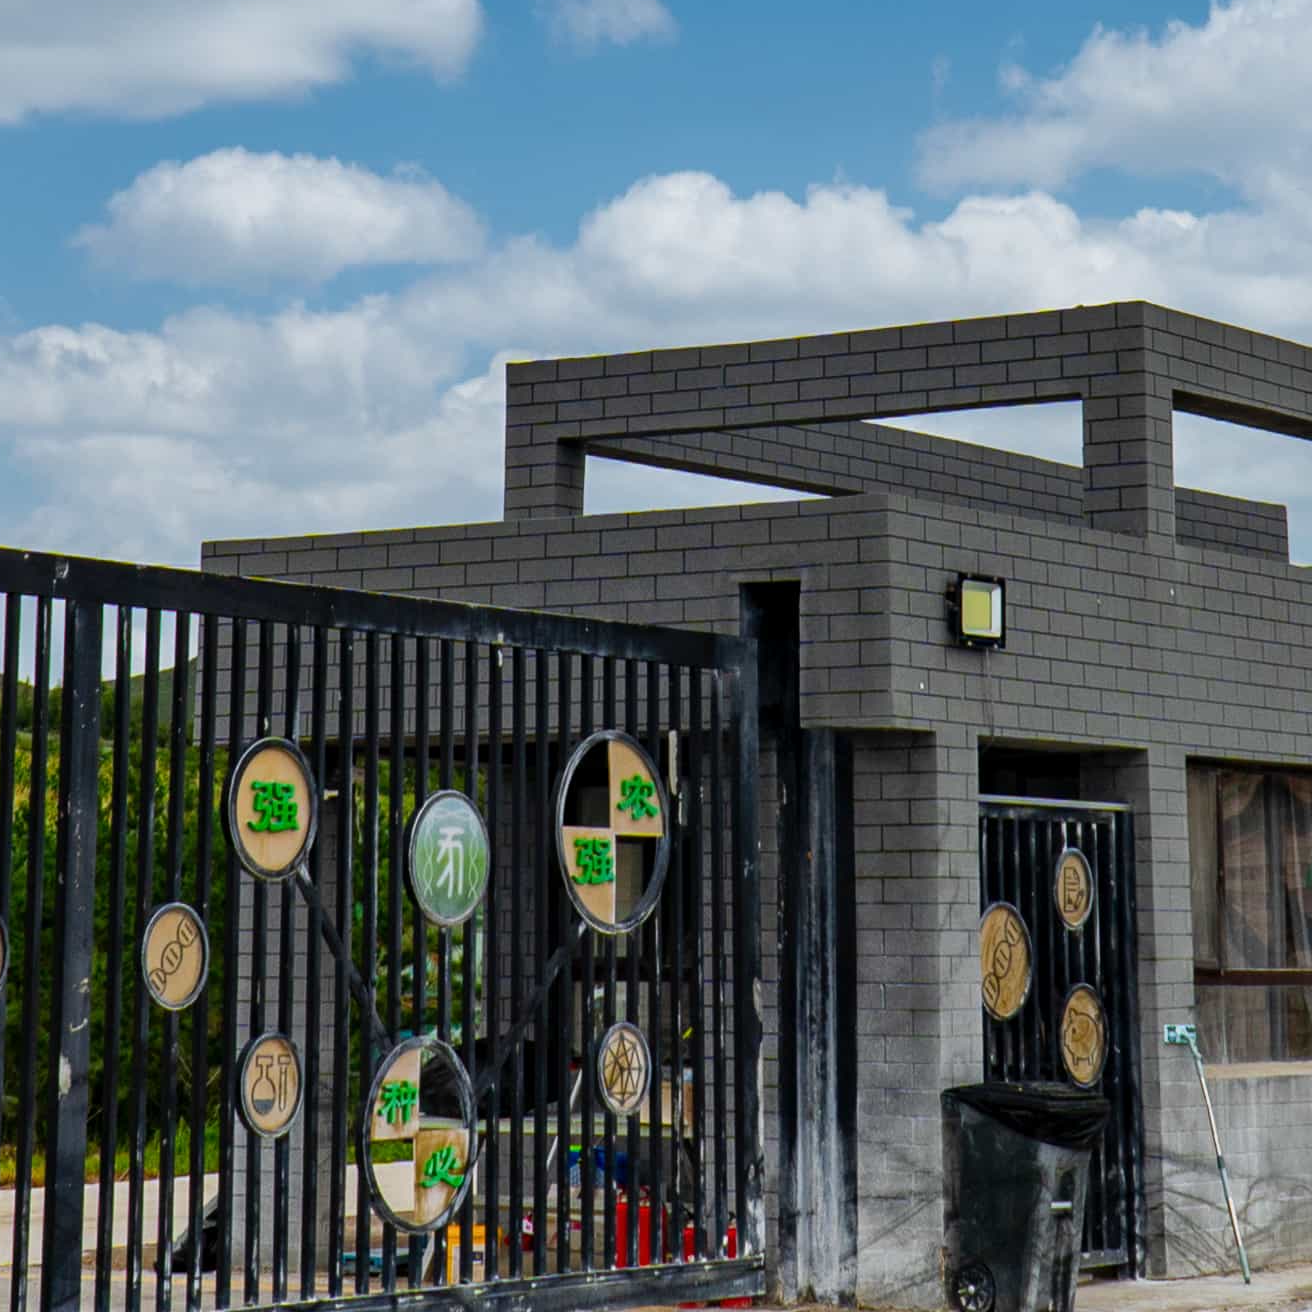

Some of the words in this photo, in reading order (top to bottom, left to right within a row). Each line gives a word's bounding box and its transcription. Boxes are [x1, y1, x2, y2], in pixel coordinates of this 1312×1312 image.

[247, 780, 299, 833] 强
[616, 773, 659, 821] 农
[571, 837, 614, 885] 强
[377, 1079, 418, 1124] 种
[420, 1143, 465, 1189] 必
